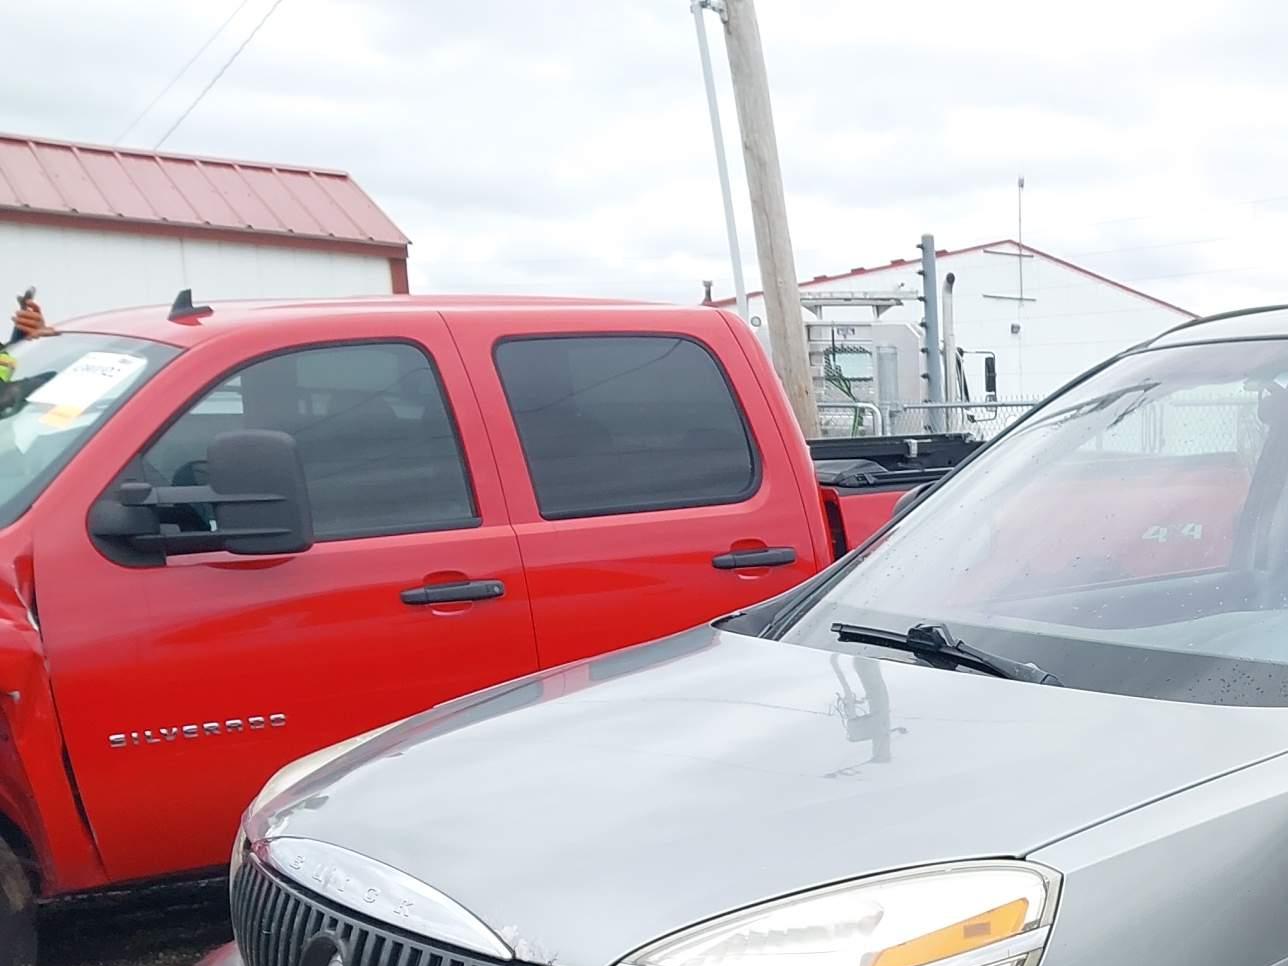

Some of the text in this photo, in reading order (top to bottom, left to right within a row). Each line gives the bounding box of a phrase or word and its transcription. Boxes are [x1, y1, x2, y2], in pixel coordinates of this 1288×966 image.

[1141, 522, 1203, 543] 44
[107, 713, 287, 748] SILVERADO
[288, 854, 416, 919] BUICK
